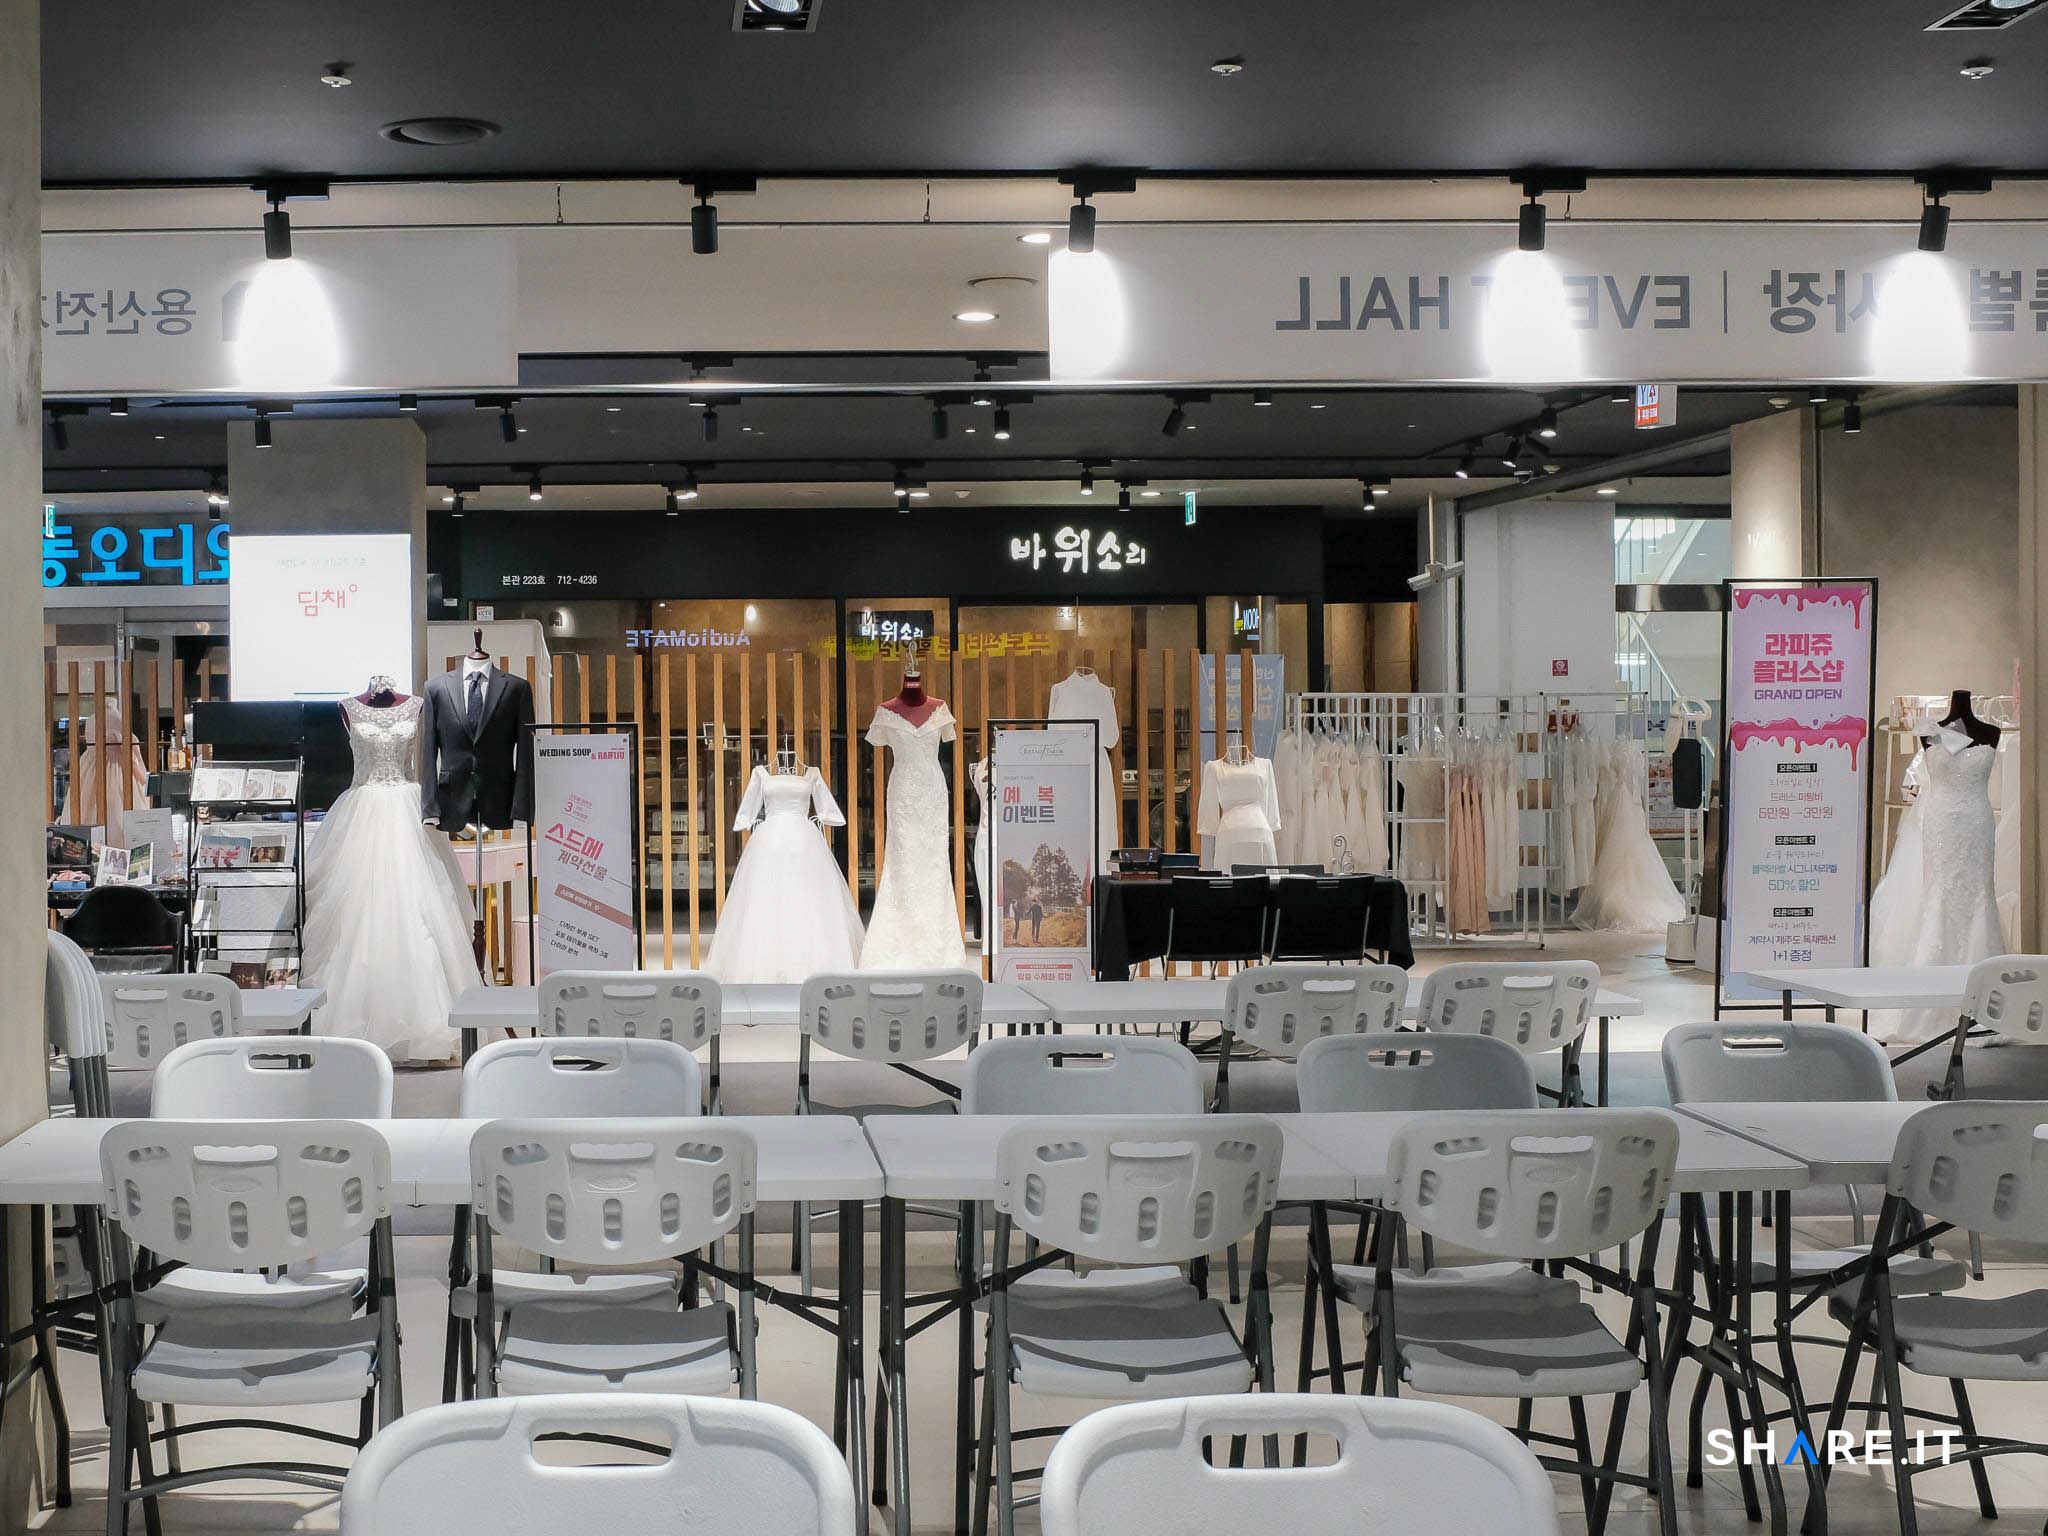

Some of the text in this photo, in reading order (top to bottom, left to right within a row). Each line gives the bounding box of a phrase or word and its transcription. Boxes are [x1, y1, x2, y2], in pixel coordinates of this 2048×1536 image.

[1010, 526, 1146, 574] 바위소리
[502, 575, 598, 586] 본관 223호 712-4236
[861, 620, 923, 642] 바위소리
[1765, 633, 1833, 656] 라피쥬
[1753, 660, 1845, 683] 플러스샵
[1754, 688, 1842, 700] GRAND OPEN
[572, 748, 592, 757] SOUP
[1003, 806, 1055, 823] 이벤트
[544, 823, 605, 861] 스드메
[557, 849, 608, 881] 계약선물
[1768, 879, 1796, 891] 50%
[588, 934, 600, 943] SET
